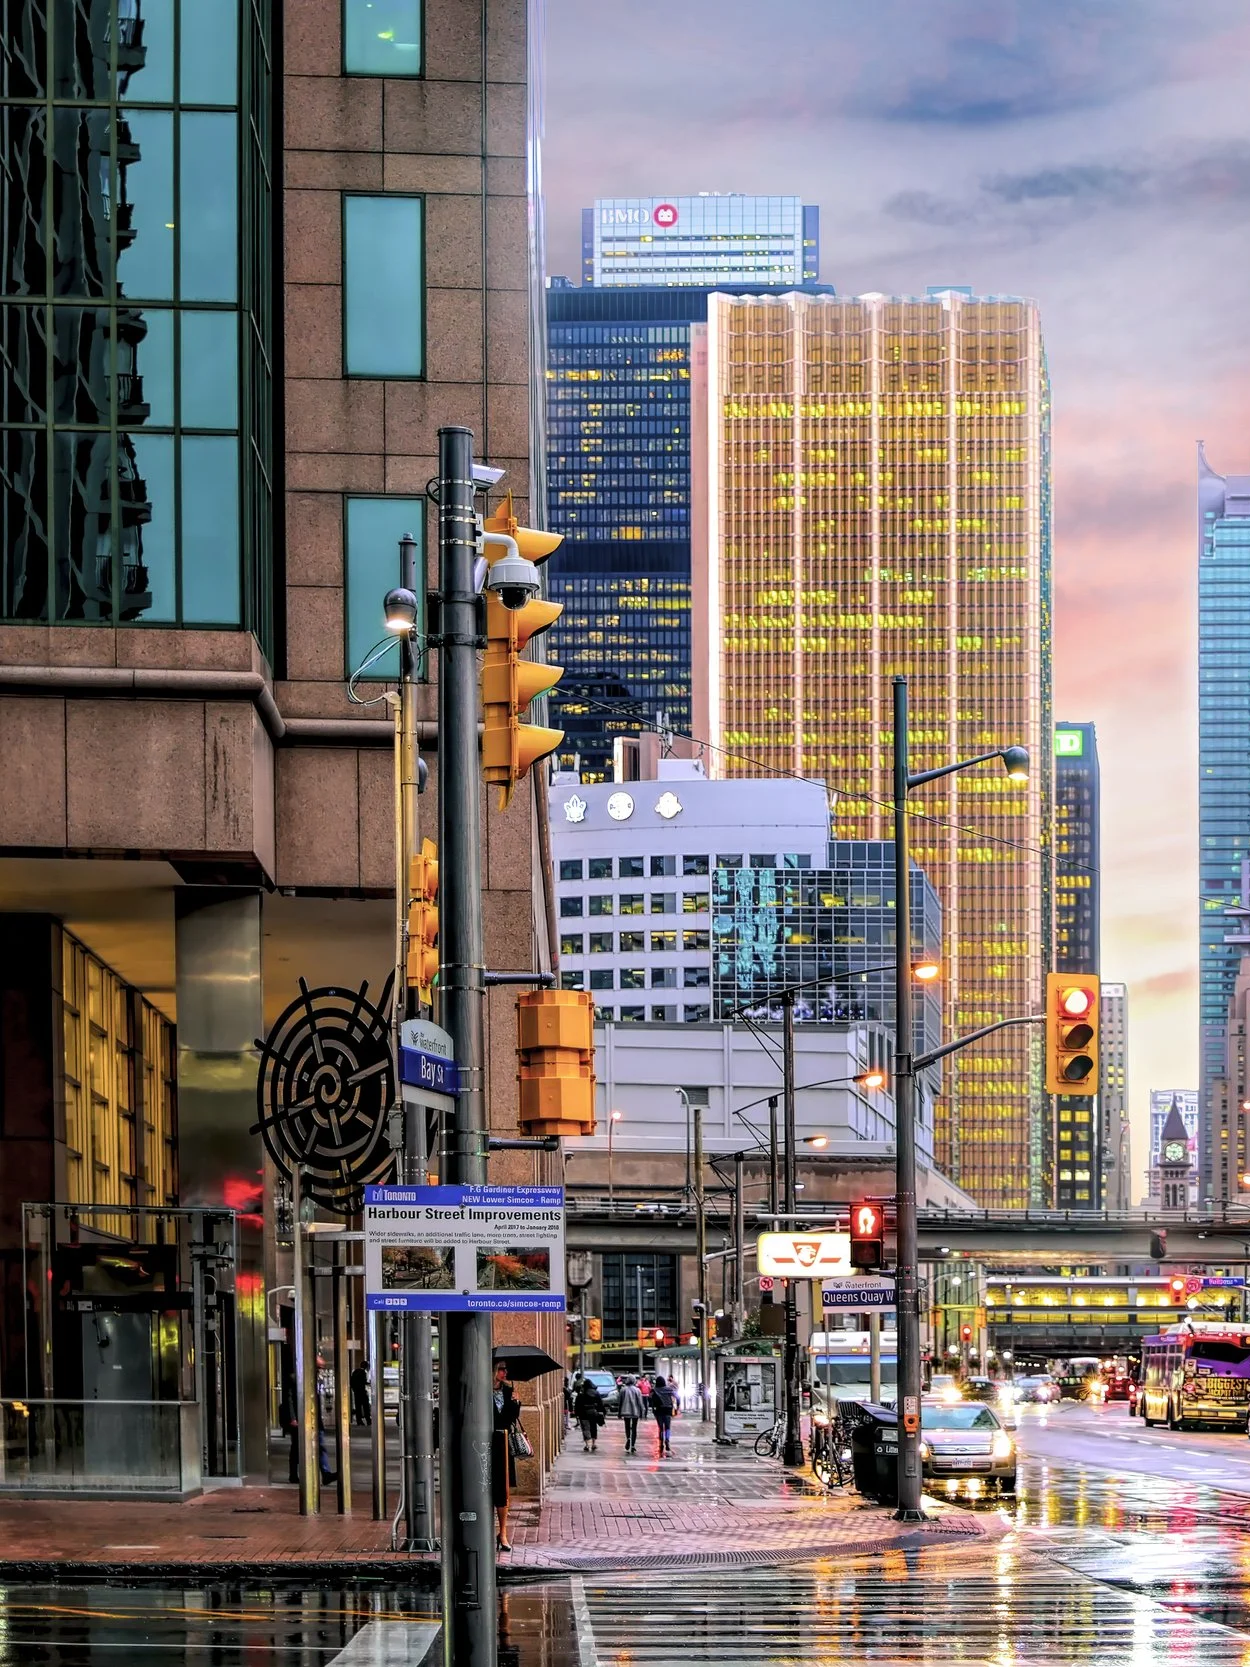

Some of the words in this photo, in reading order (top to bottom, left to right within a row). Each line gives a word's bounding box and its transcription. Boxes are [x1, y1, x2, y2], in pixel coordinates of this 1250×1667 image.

[602, 209, 650, 224] BMO
[1055, 734, 1080, 752] TD
[421, 1055, 436, 1087] Bay
[437, 1064, 444, 1084] St
[383, 1189, 417, 1202] TORONTO
[517, 1186, 561, 1195] Expressway
[507, 1196, 534, 1204] Simcoe
[541, 1197, 561, 1205] Ramp
[368, 1207, 421, 1219] Harbour
[425, 1207, 465, 1220] Street
[469, 1208, 561, 1223] Improvements
[823, 1291, 859, 1303] Queens
[860, 1291, 884, 1303] Quay
[885, 1291, 894, 1301] W
[467, 1299, 561, 1309] toronto.ca/simcoe-ramp
[1206, 1378, 1249, 1390] BIGGEST
